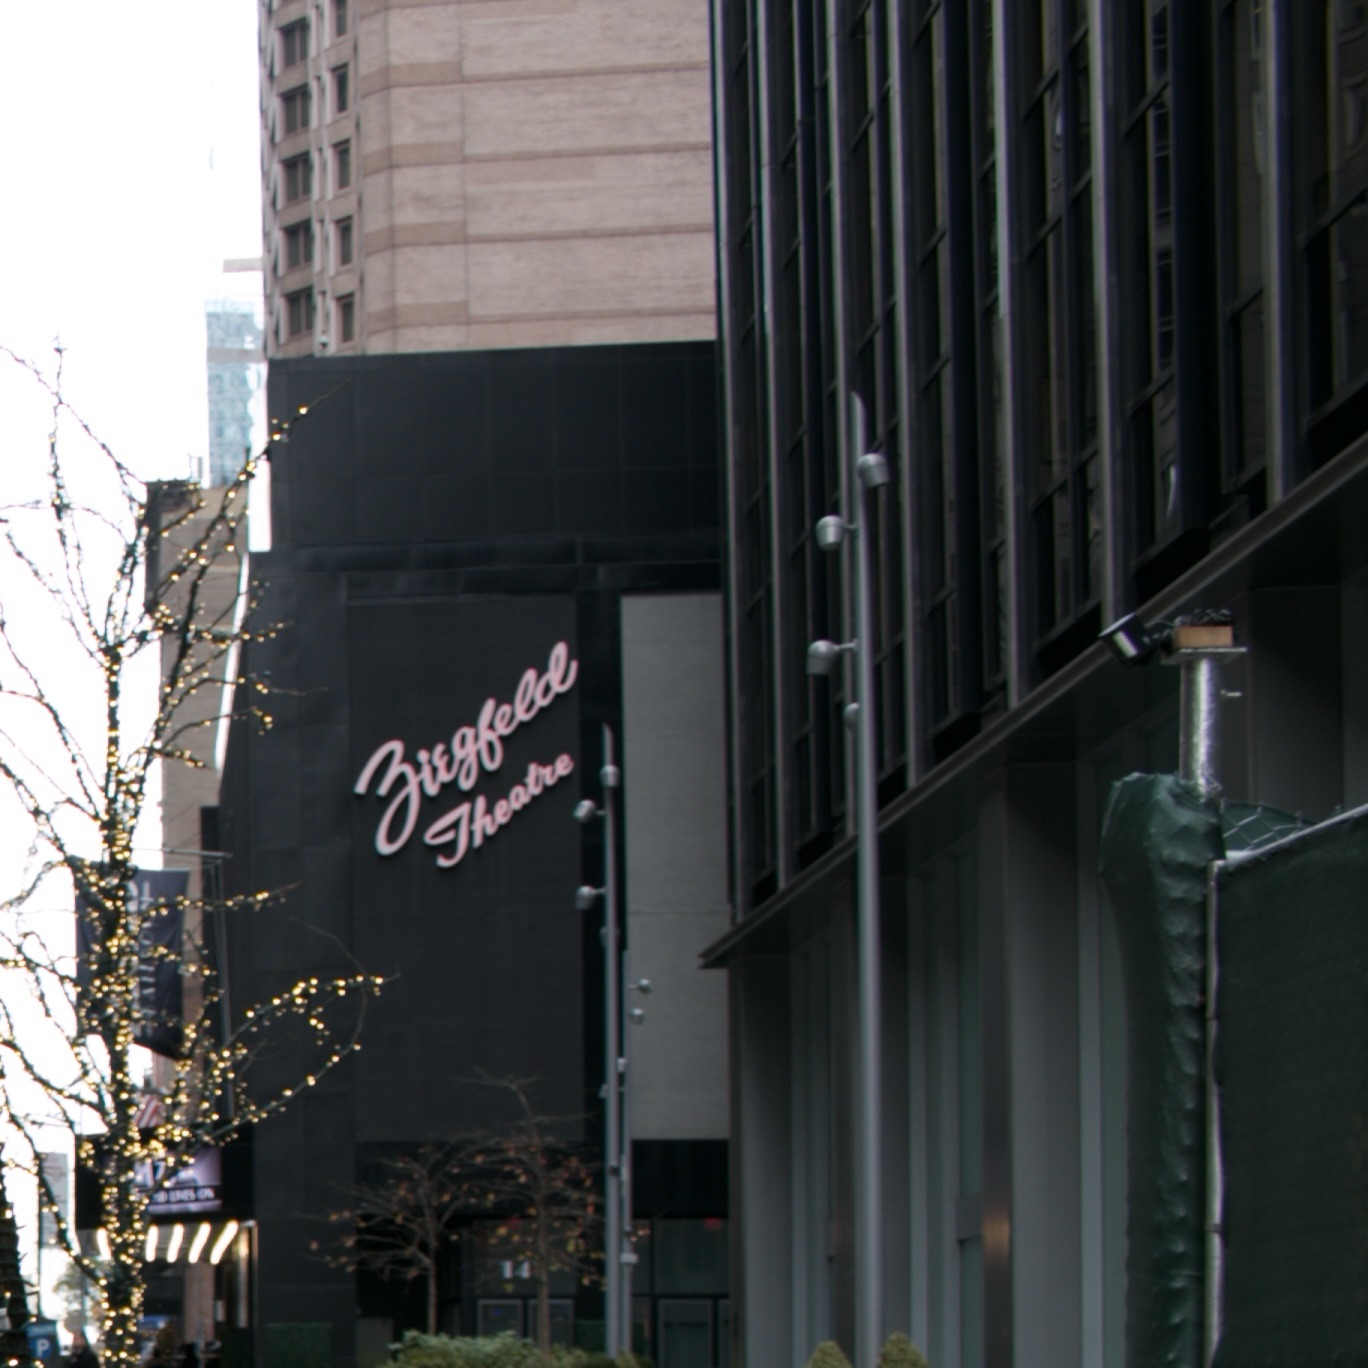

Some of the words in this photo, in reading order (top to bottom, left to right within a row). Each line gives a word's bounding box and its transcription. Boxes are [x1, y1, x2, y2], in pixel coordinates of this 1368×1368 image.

[353, 641, 578, 856] Ziegfeld
[424, 753, 574, 868] Theatre
[36, 1338, 50, 1357] P
